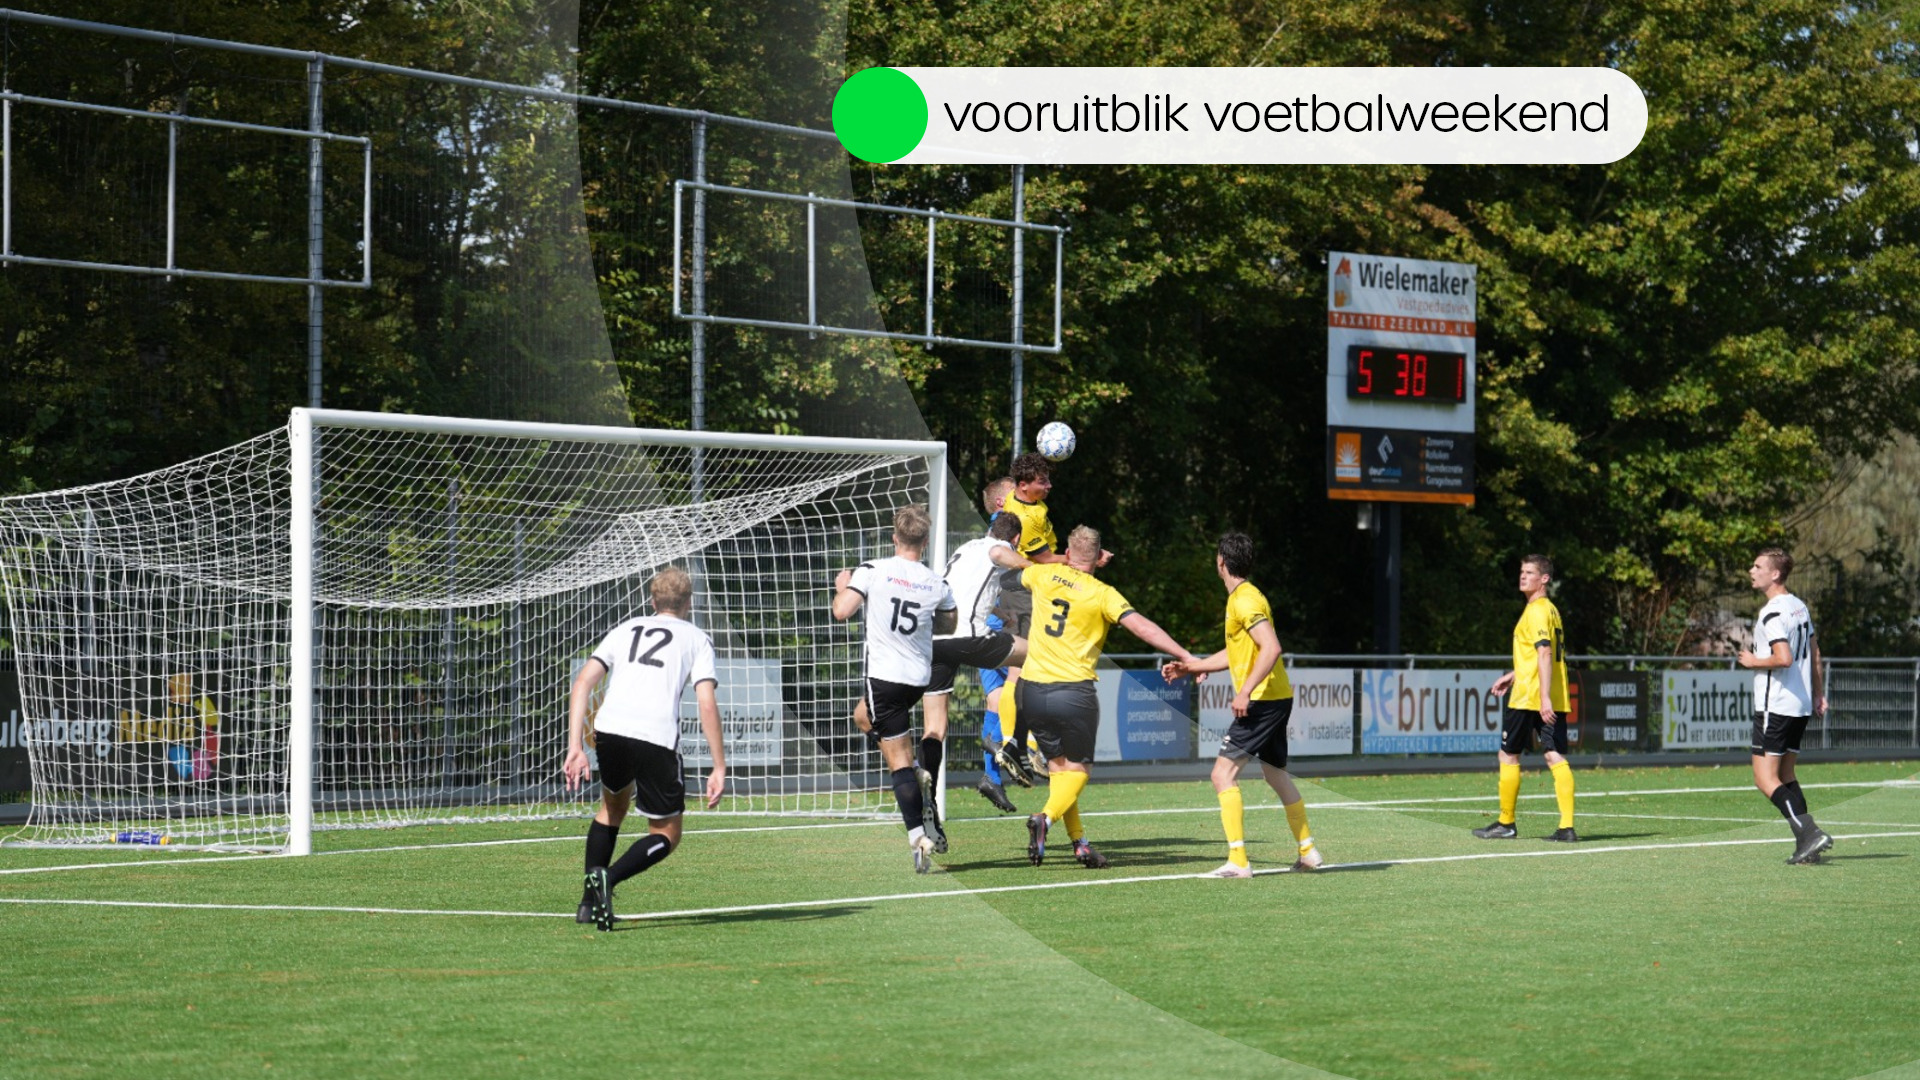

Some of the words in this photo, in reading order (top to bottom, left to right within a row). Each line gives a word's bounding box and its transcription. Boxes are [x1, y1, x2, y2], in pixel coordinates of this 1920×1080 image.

[1358, 261, 1470, 296] Wielemaker
[1397, 297, 1470, 315] Vastgoedadvies
[1358, 350, 1373, 393] 5
[1394, 354, 1427, 396] 38
[1456, 358, 1463, 398] 1
[890, 597, 921, 636] 15
[1045, 598, 1070, 638] 3
[628, 625, 673, 668] 12
[1299, 684, 1351, 708] ROTIKO
[1398, 672, 1499, 732] bruine
[120, 707, 195, 743] Media
[1309, 722, 1352, 740] installatie
[1707, 729, 1735, 742] GROENE
[1363, 736, 1429, 752] HYPOTHEKEN
